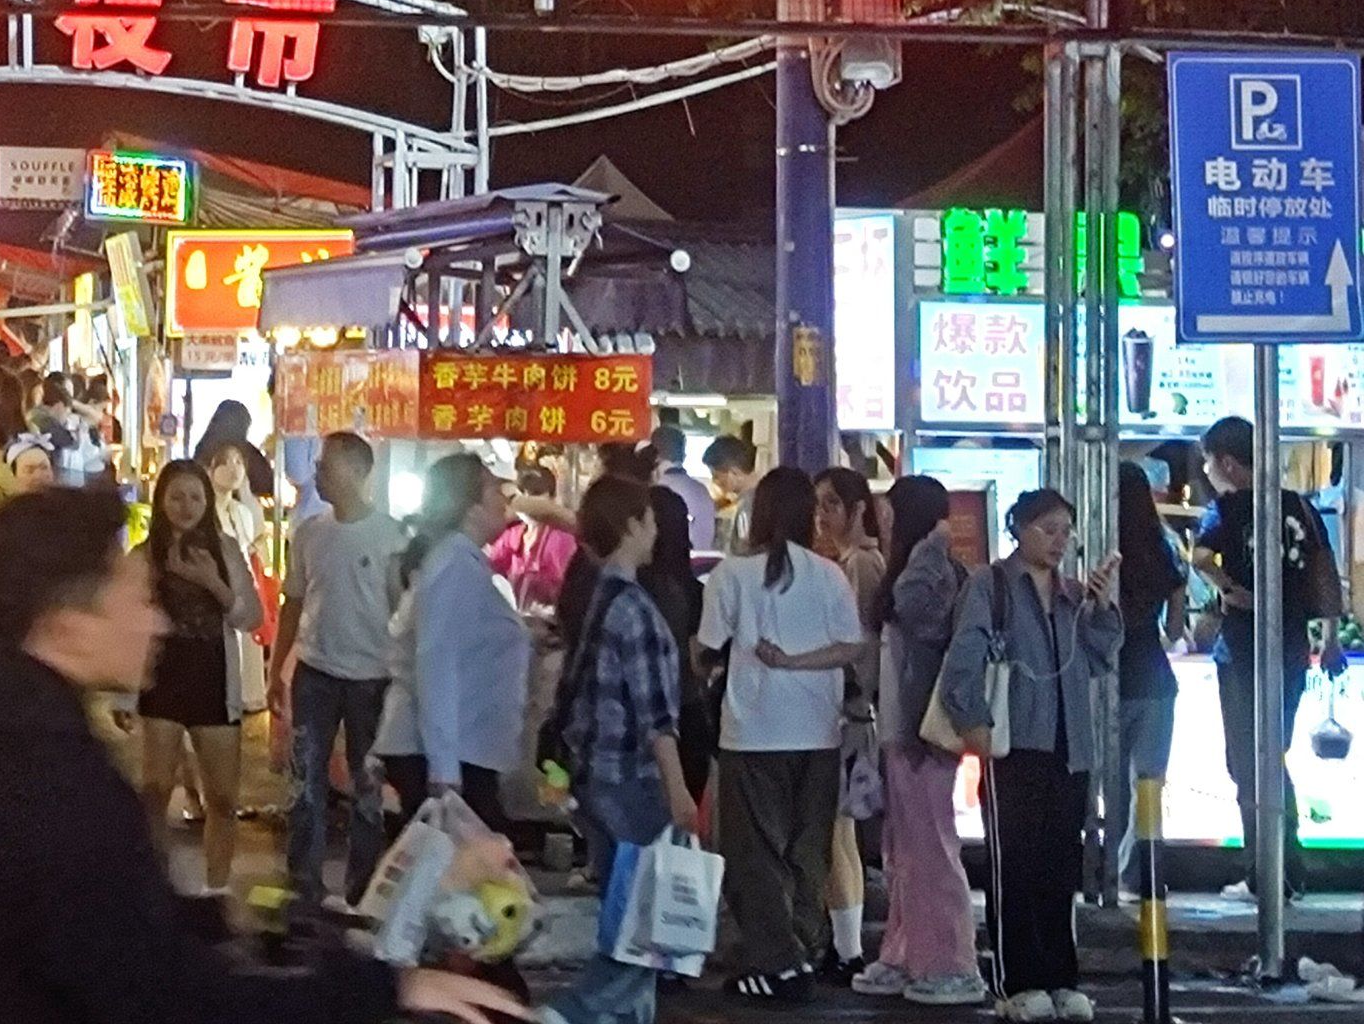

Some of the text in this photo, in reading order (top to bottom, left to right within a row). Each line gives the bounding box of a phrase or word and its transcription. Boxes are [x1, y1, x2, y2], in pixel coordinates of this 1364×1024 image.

[1240, 80, 1278, 141] P
[1204, 157, 1335, 192] 电动车
[1207, 196, 1333, 219] 临时停放处
[1220, 226, 1318, 246] 温馨提示
[933, 312, 1029, 355] 爆款
[433, 362, 639, 393] 香芋牛肉饼 8元
[933, 369, 1027, 413] 饮品
[432, 404, 635, 436] 香芋肉饼 6元
